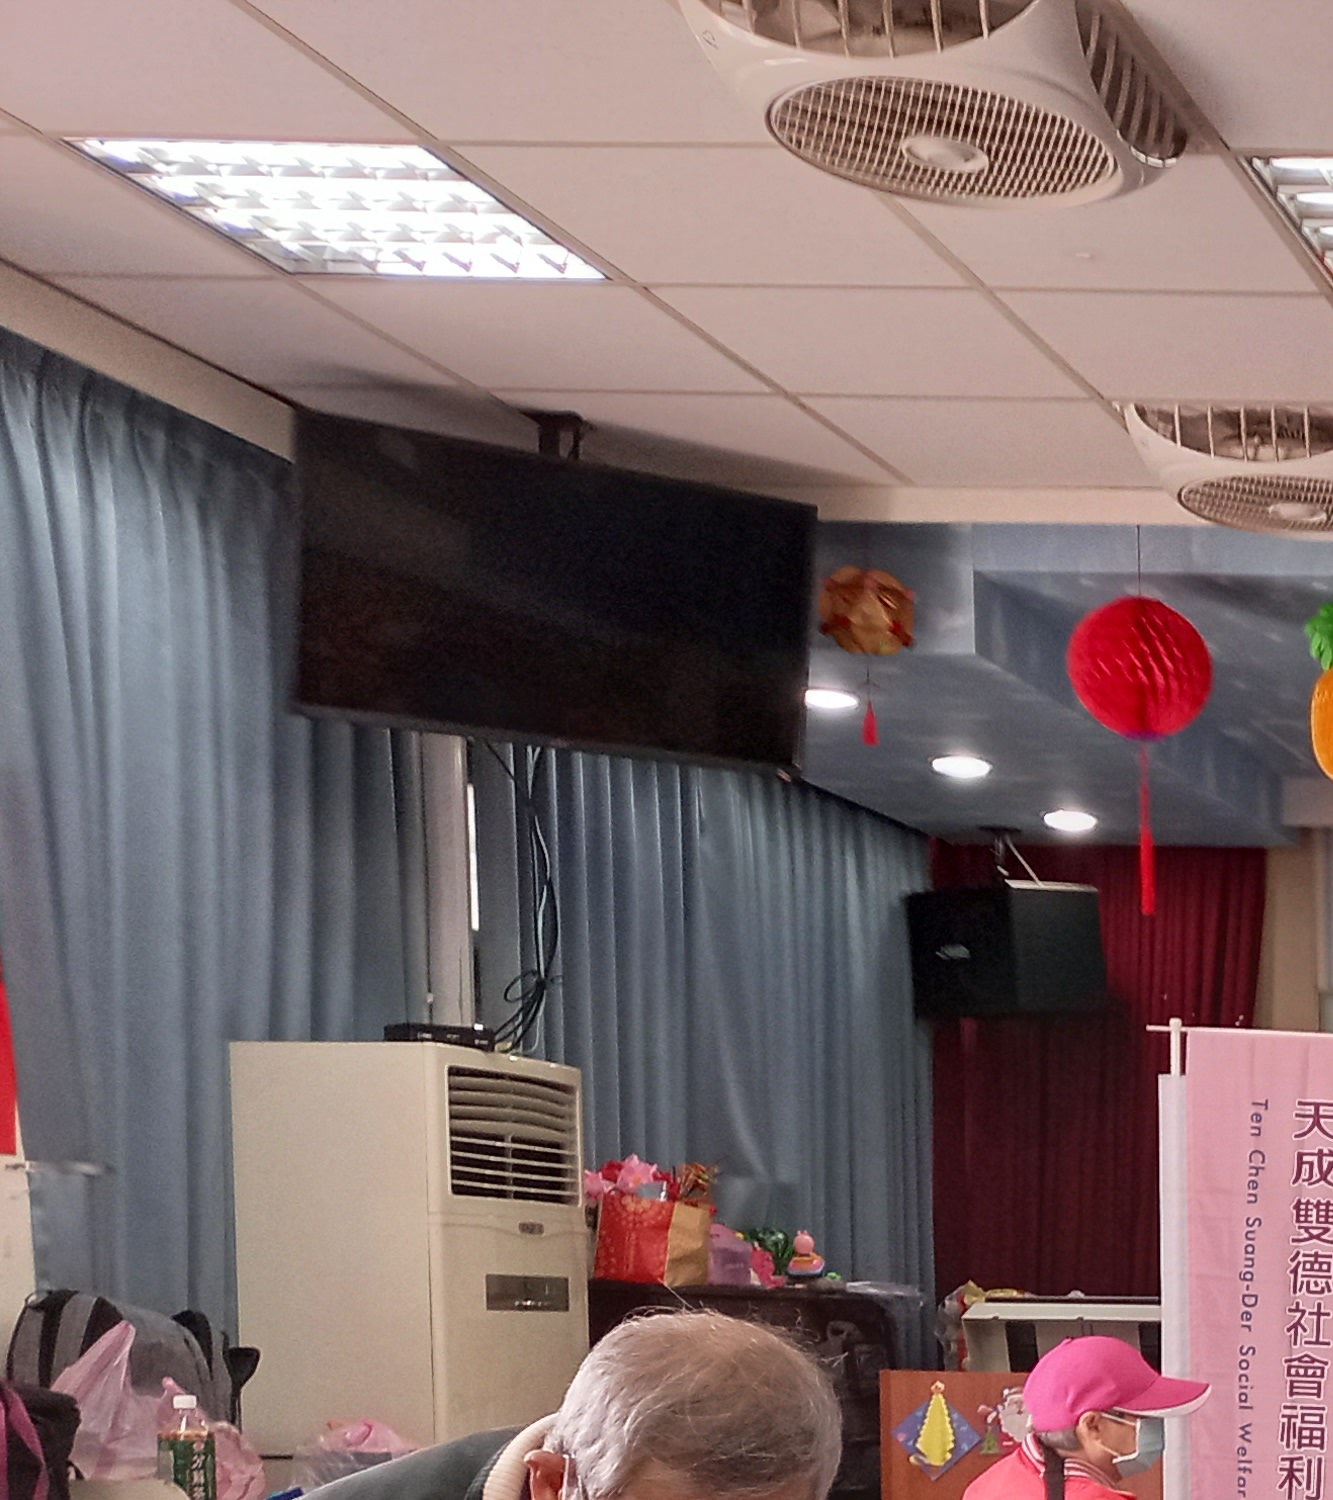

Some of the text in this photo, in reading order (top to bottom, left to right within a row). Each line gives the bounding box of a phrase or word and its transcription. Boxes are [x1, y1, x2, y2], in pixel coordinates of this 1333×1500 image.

[1250, 1099, 1268, 1137] Ten
[1247, 1149, 1266, 1205] Chen
[1239, 1216, 1262, 1333] Suang-Der
[1238, 1345, 1256, 1410] Social
